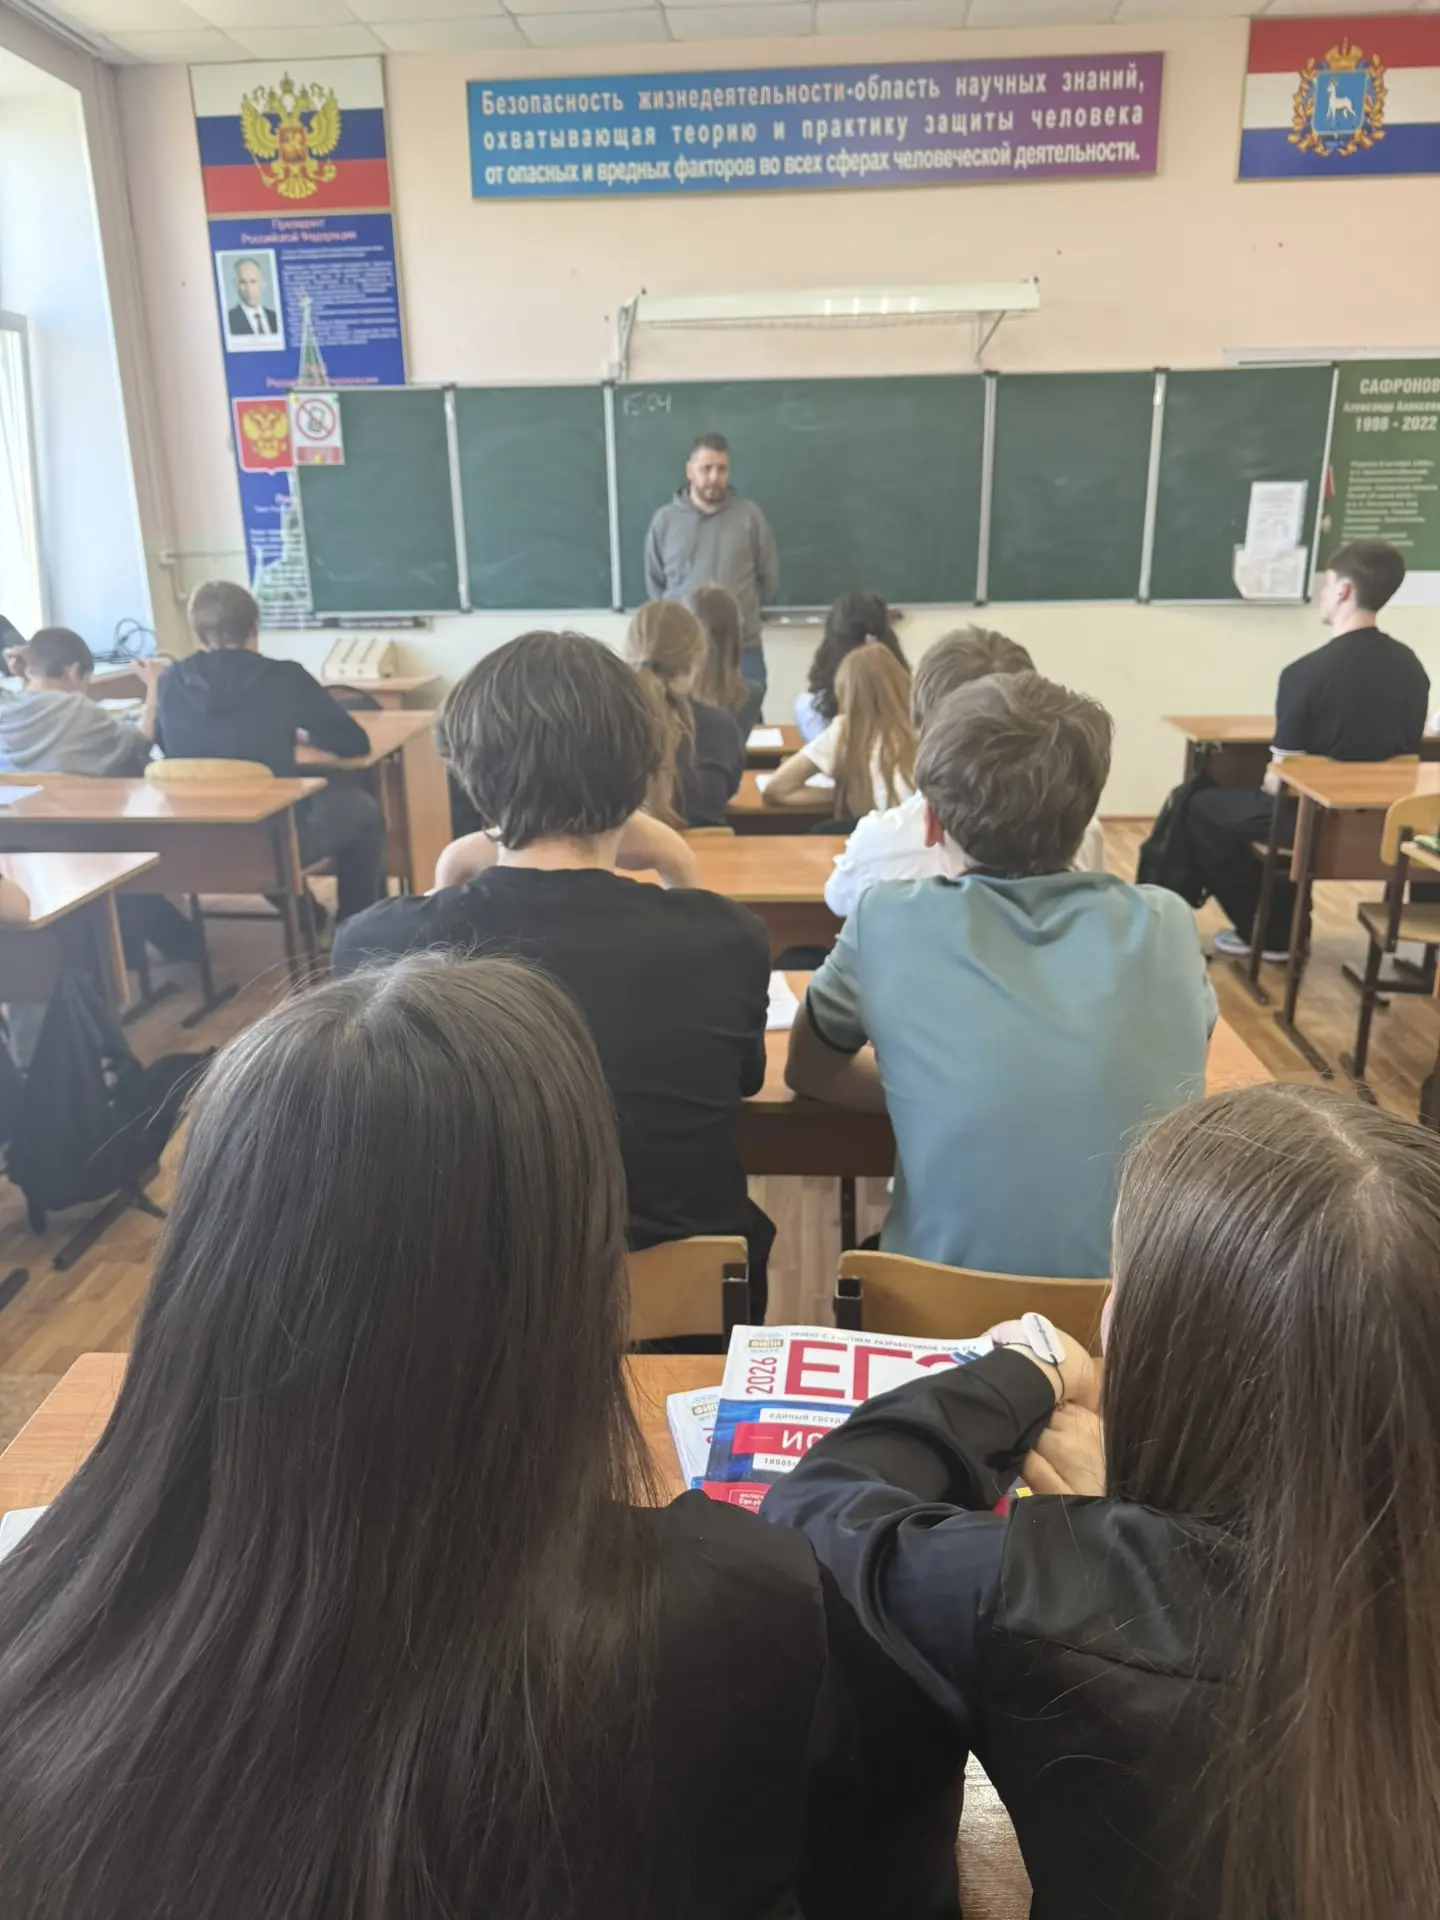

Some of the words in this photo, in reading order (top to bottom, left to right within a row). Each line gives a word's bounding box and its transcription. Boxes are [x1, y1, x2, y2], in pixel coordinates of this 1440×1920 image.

[481, 90, 624, 116] Безопасность
[956, 71, 1047, 103] научных
[1062, 62, 1145, 94] знаний,
[483, 125, 656, 151] охватывающая
[672, 121, 757, 148] теорию
[773, 121, 785, 140] и
[802, 115, 908, 144] практику
[924, 110, 1015, 136] защиты
[1031, 104, 1144, 129] человека
[484, 166, 504, 185] от
[507, 163, 580, 185] опасных
[582, 162, 594, 182] и
[597, 159, 671, 187] вредных
[674, 154, 756, 184] факторов
[759, 156, 779, 175] во
[784, 155, 822, 174] всех
[826, 148, 889, 178] сферах
[893, 142, 1011, 169] человеческой
[1014, 140, 1140, 170] деятельности.
[1401, 415, 1437, 431] 2022
[746, 1357, 777, 1395] 2026
[784, 1339, 960, 1401] ЕГ
[769, 1412, 809, 1421] ЕДИНЫЙ
